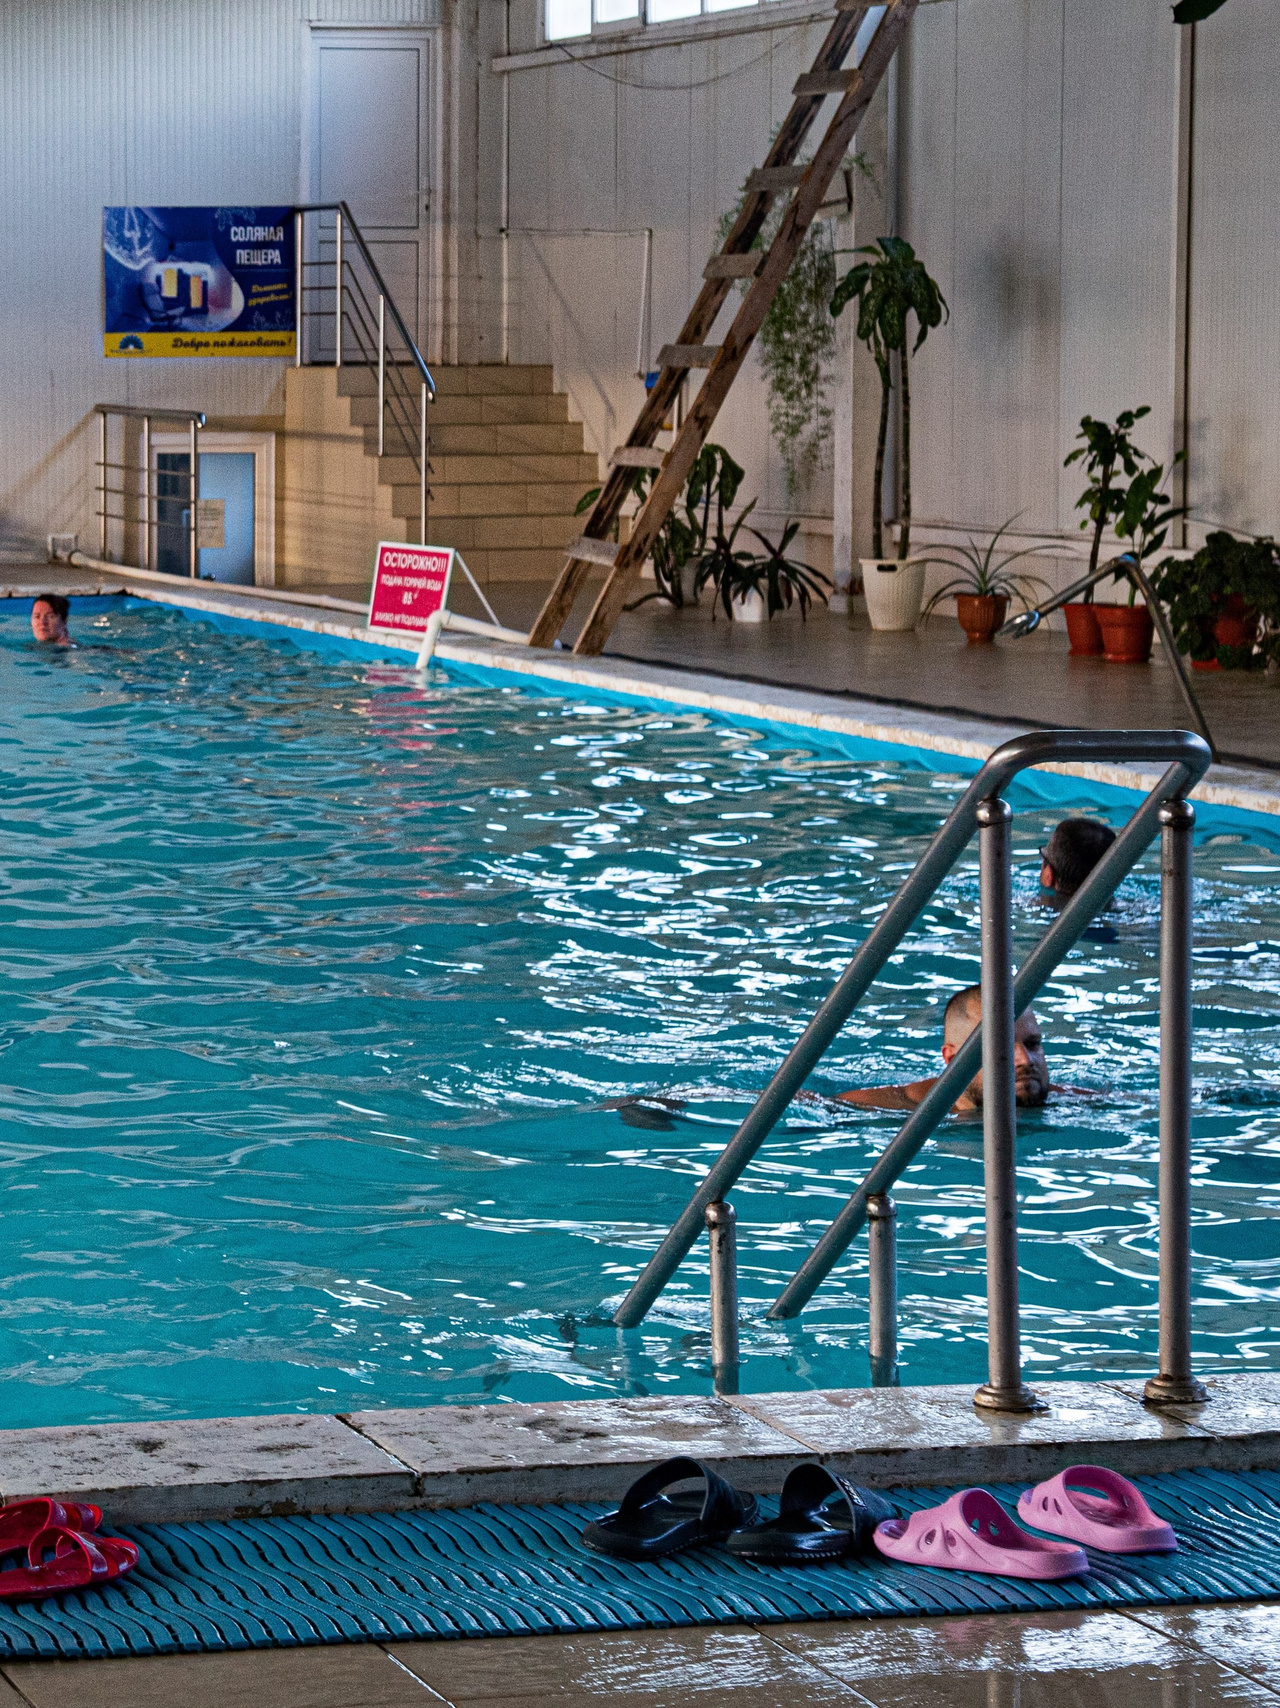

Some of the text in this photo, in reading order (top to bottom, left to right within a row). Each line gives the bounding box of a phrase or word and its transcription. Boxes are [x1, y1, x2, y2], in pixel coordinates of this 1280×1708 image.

[230, 226, 284, 241] СОЛЯНАЯ
[236, 249, 281, 266] ПЕЩЕРА
[172, 336, 293, 352] Добро пожаловать!
[383, 551, 447, 573] ОСТОРОЖНО!!!
